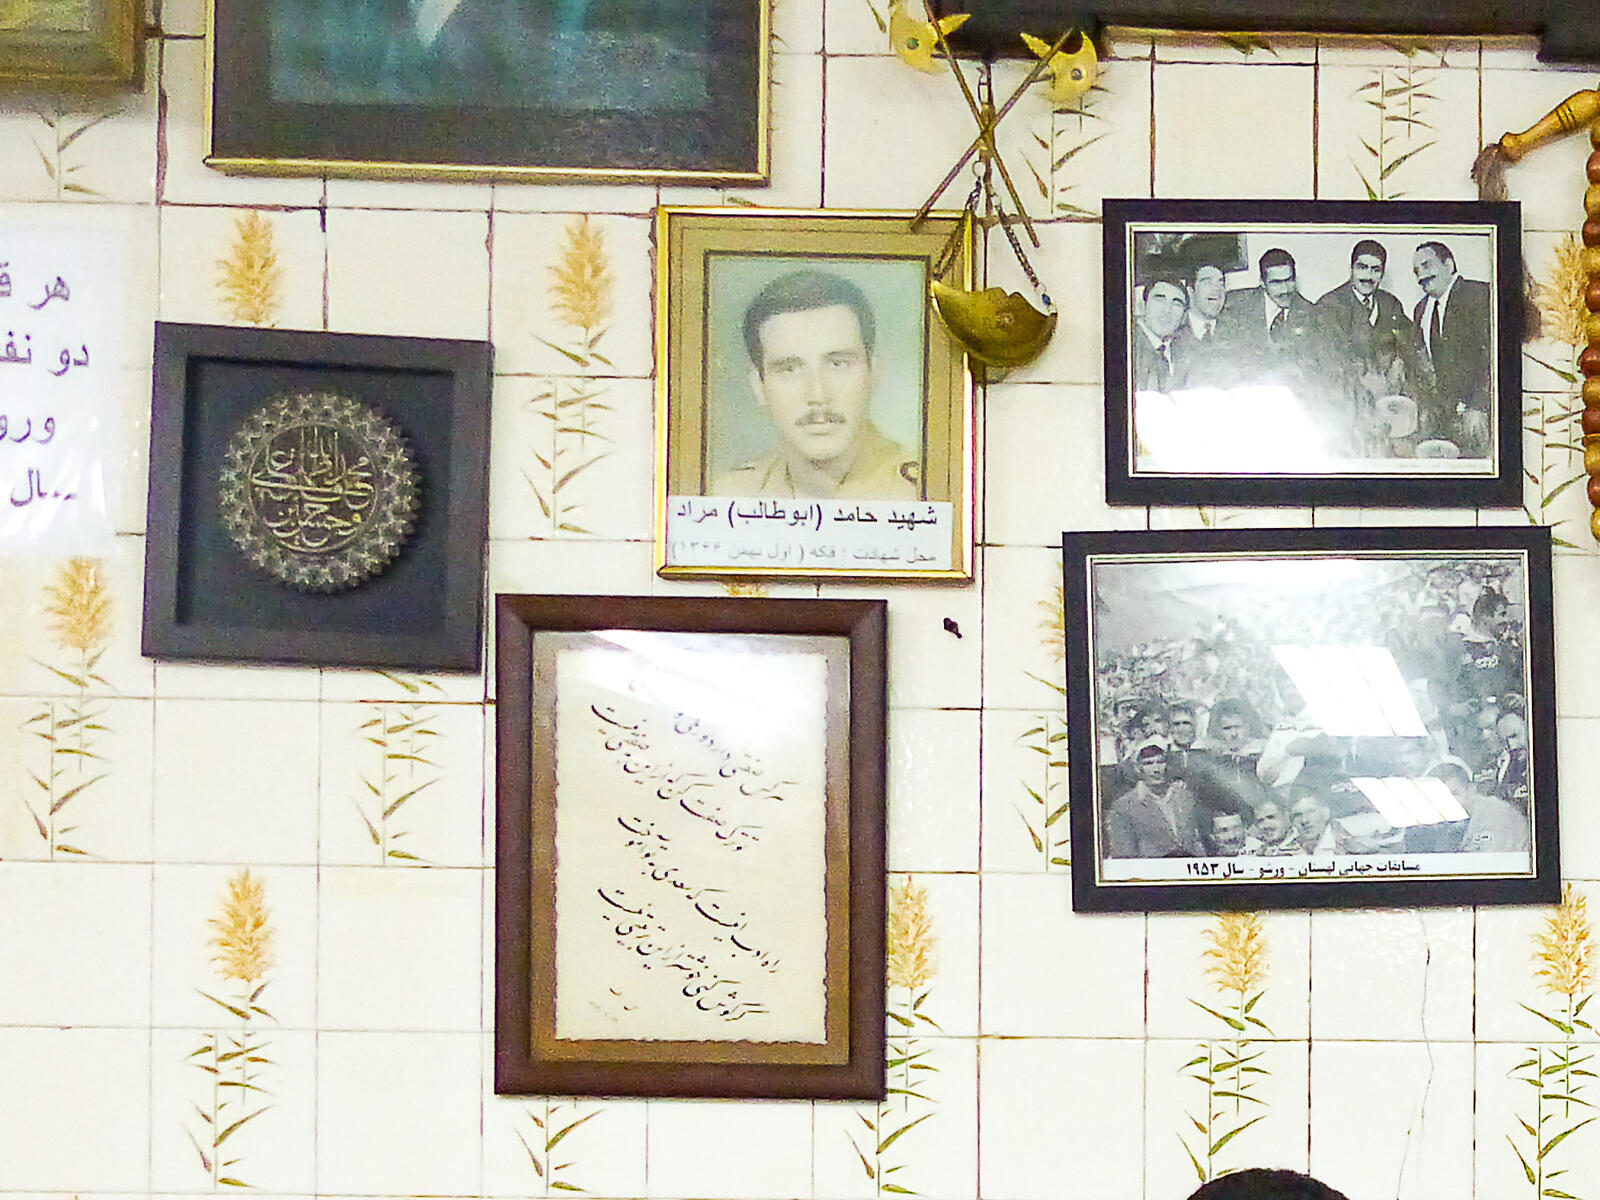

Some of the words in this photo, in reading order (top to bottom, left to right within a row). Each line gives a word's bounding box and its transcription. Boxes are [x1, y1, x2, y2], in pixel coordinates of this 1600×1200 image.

[28, 275, 71, 311] هر
[49, 343, 90, 377] دو
[833, 505, 878, 523] حامد
[887, 506, 938, 531] شهید
[1222, 862, 1244, 879] سال
